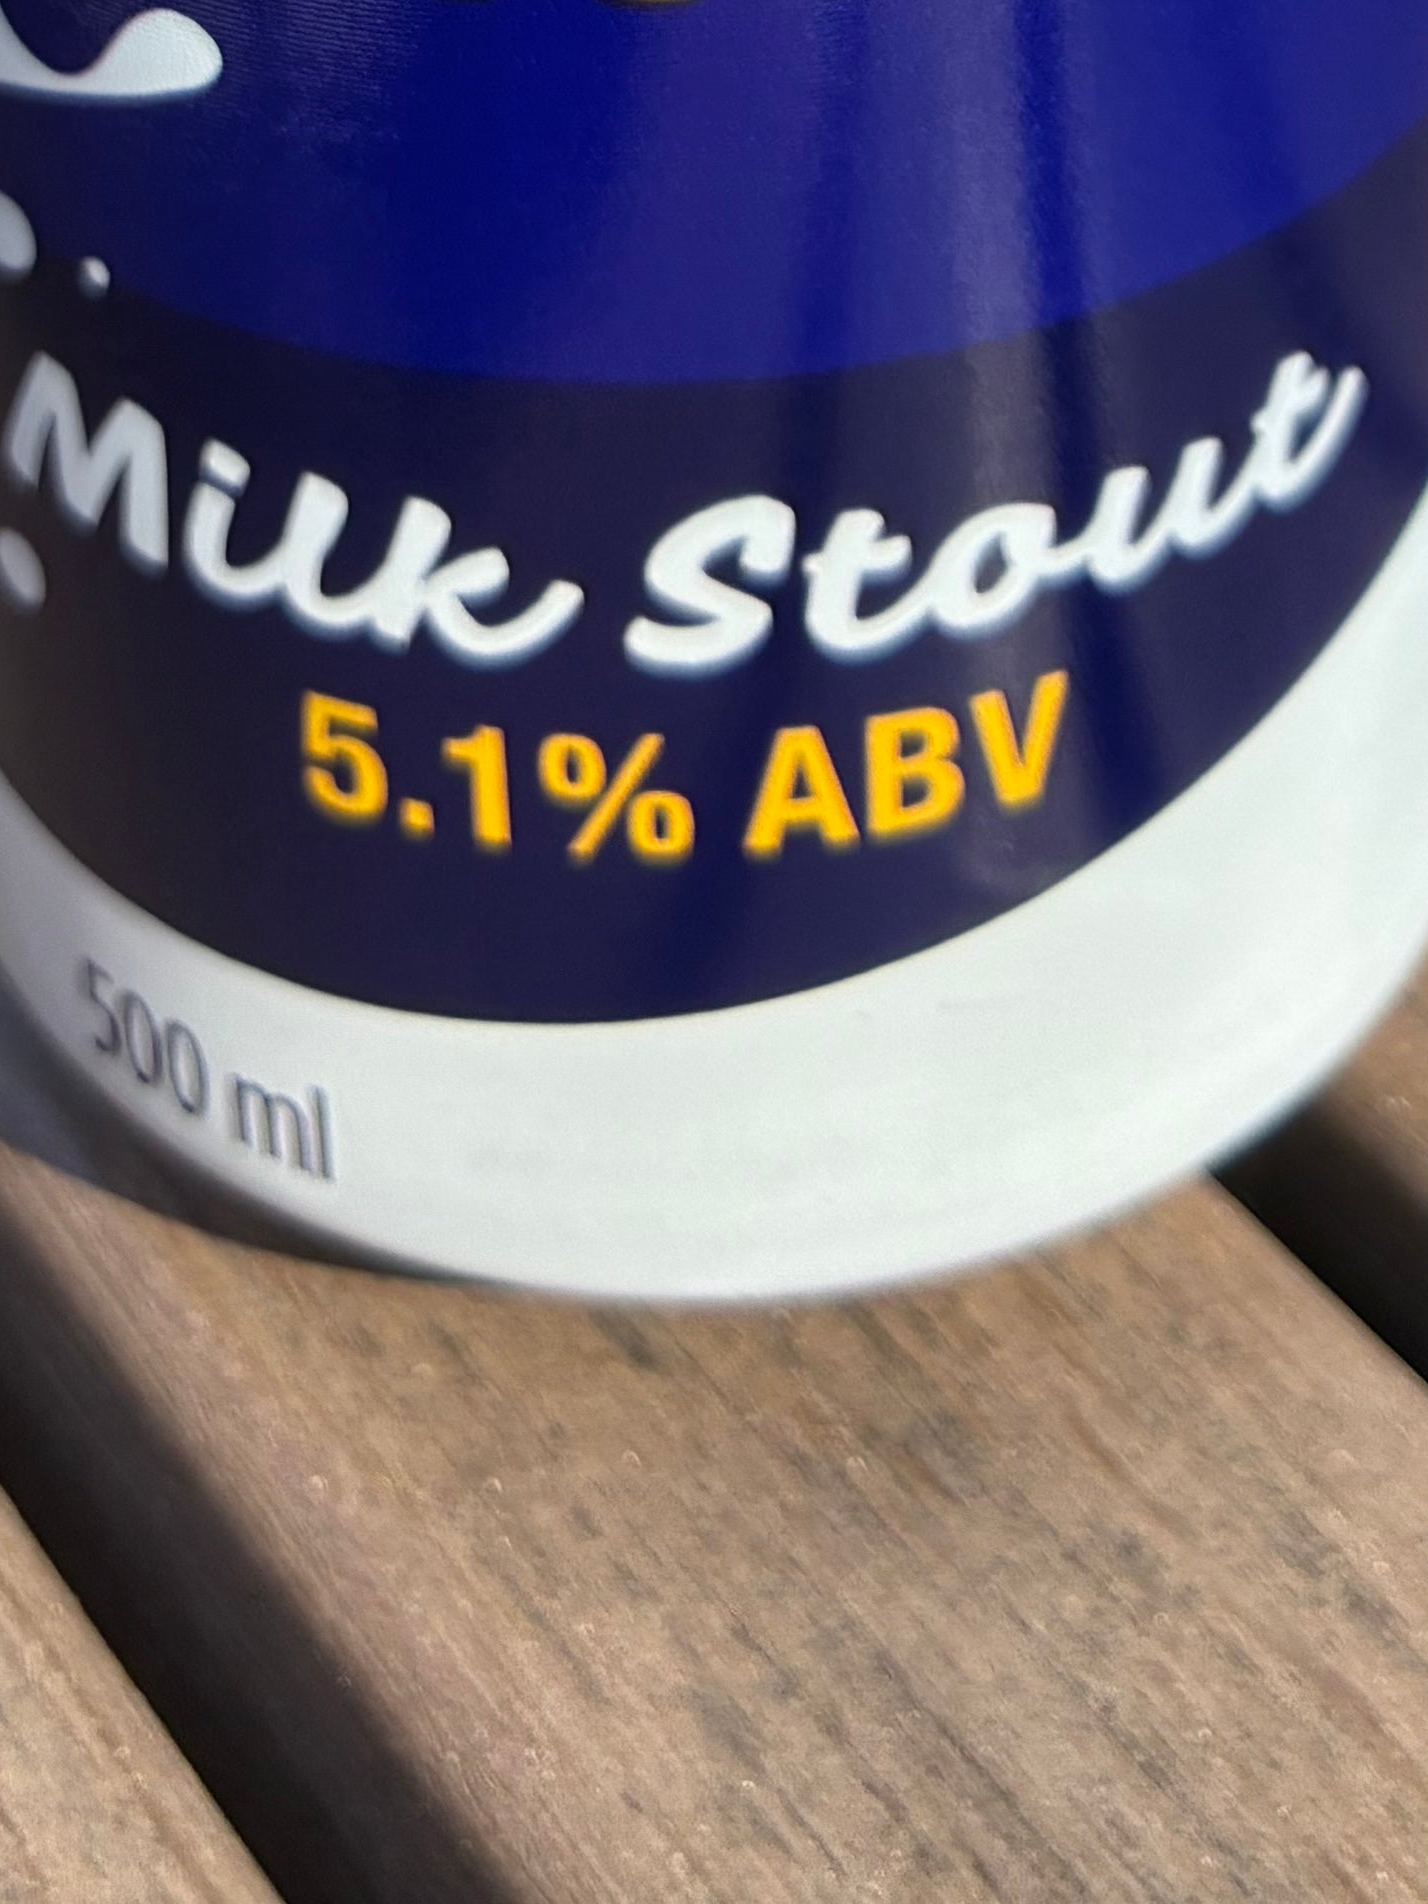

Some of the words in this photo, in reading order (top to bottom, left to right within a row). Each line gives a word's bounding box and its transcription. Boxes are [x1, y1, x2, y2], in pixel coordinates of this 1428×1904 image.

[7, 350, 586, 665] Milk
[624, 349, 1366, 673] Stout
[300, 691, 697, 861] 5.1%
[744, 670, 1071, 858] ABV
[76, 953, 212, 1119] 500
[231, 1068, 336, 1182] ml
